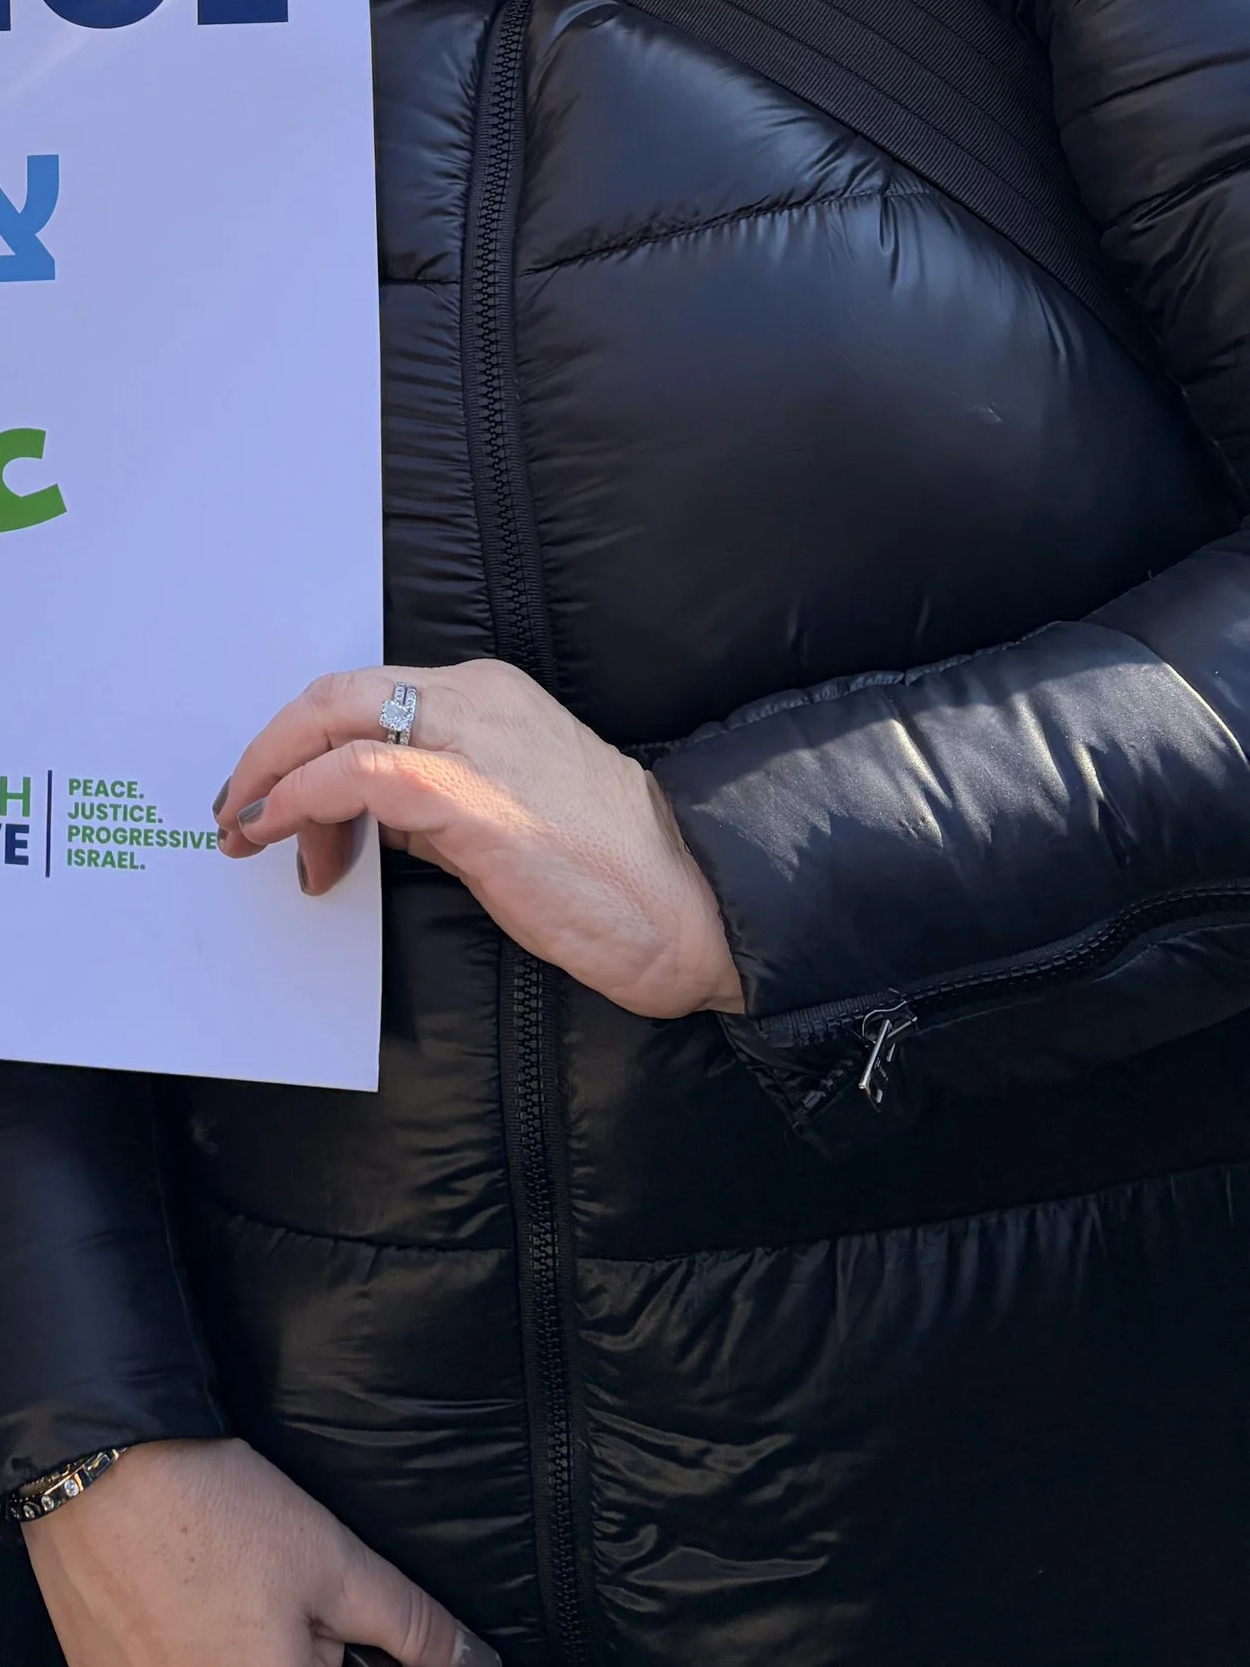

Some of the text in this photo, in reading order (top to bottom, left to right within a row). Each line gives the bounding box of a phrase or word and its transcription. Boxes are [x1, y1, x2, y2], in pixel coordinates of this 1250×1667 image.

[68, 778, 144, 799] PEACE.
[67, 802, 163, 824] JUSTICE.
[67, 825, 217, 850] PROGRESSIVE
[66, 848, 145, 870] ISRAEL.
